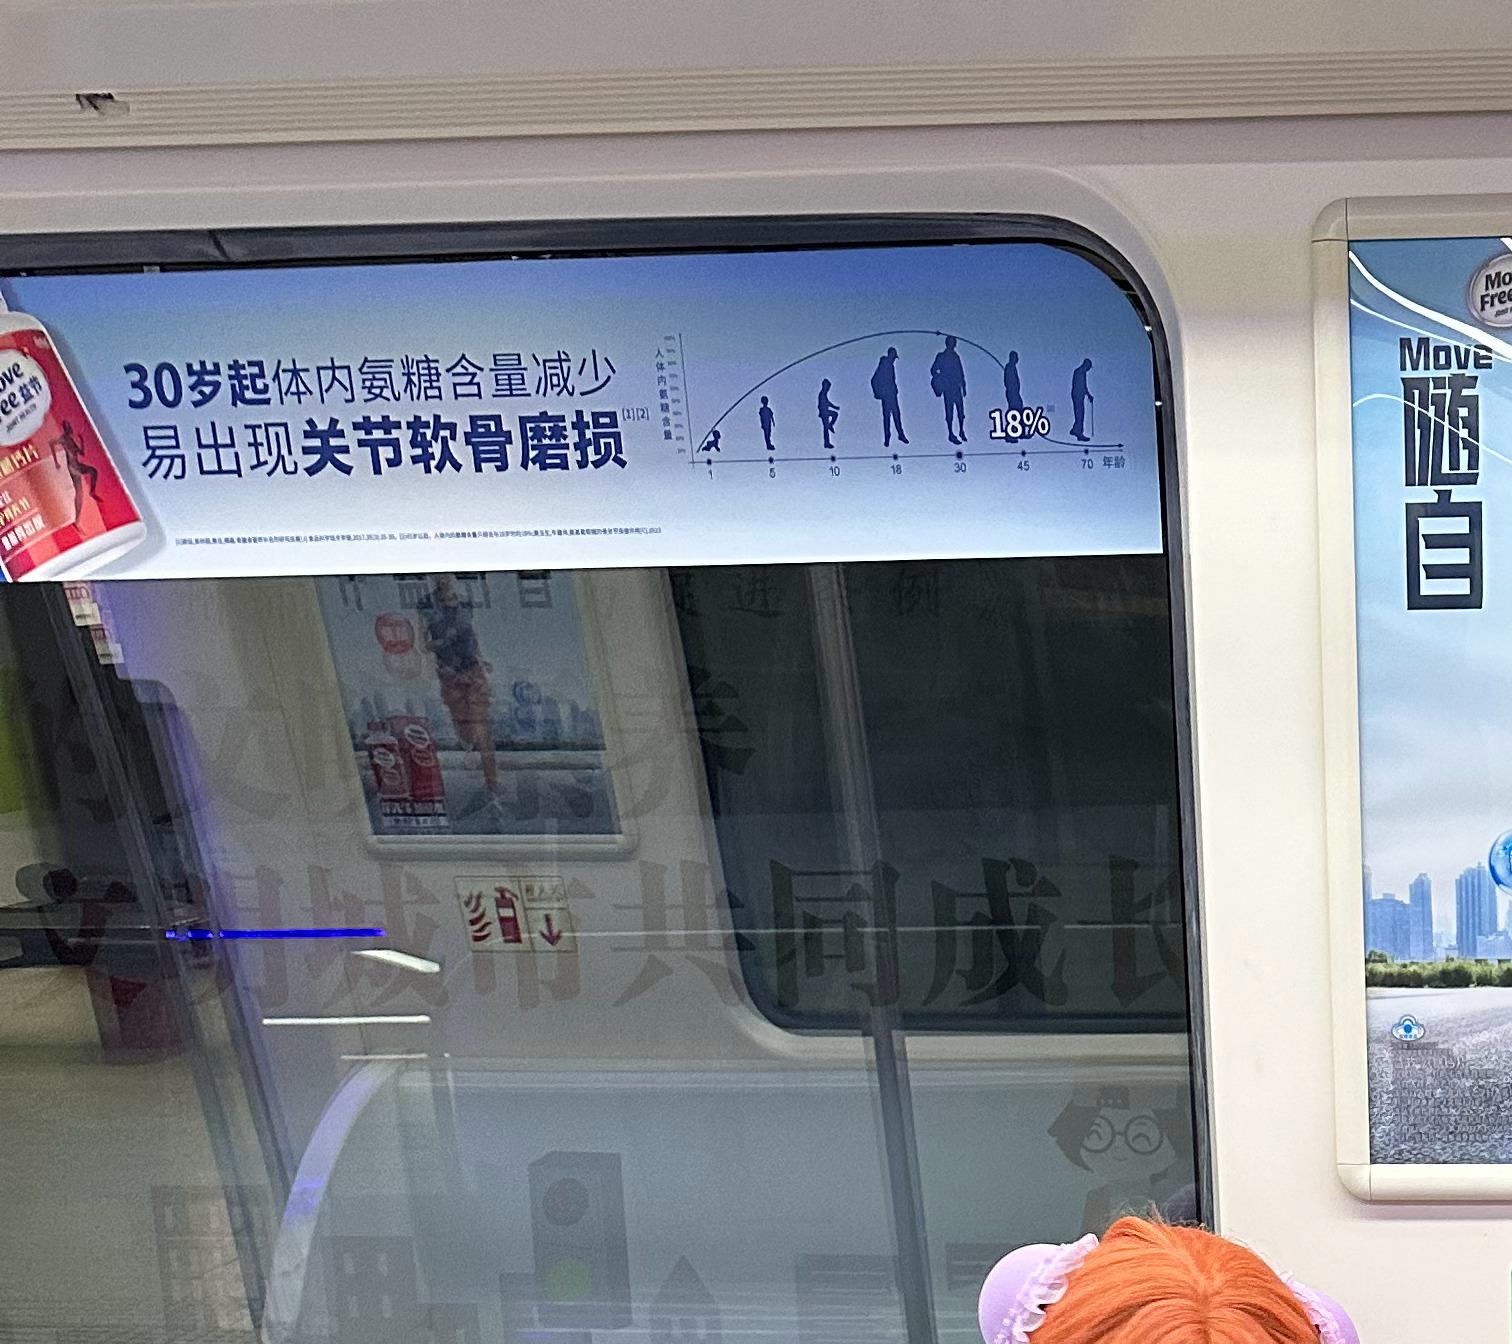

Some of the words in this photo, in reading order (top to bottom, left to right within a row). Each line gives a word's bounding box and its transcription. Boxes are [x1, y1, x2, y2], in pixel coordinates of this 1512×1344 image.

[1400, 337, 1493, 372] Move
[0, 362, 24, 393] ove
[123, 348, 617, 410] 30岁起体内氨糖含量减少
[990, 408, 1049, 439] 18%
[142, 409, 628, 481] 易出现关节软骨磨损
[769, 467, 776, 479] 5
[829, 465, 841, 477] 10
[890, 463, 902, 475] 18
[954, 462, 967, 474] 30
[1017, 460, 1030, 472] 45
[1081, 458, 1094, 470] 70
[1102, 455, 1126, 469] 年龄
